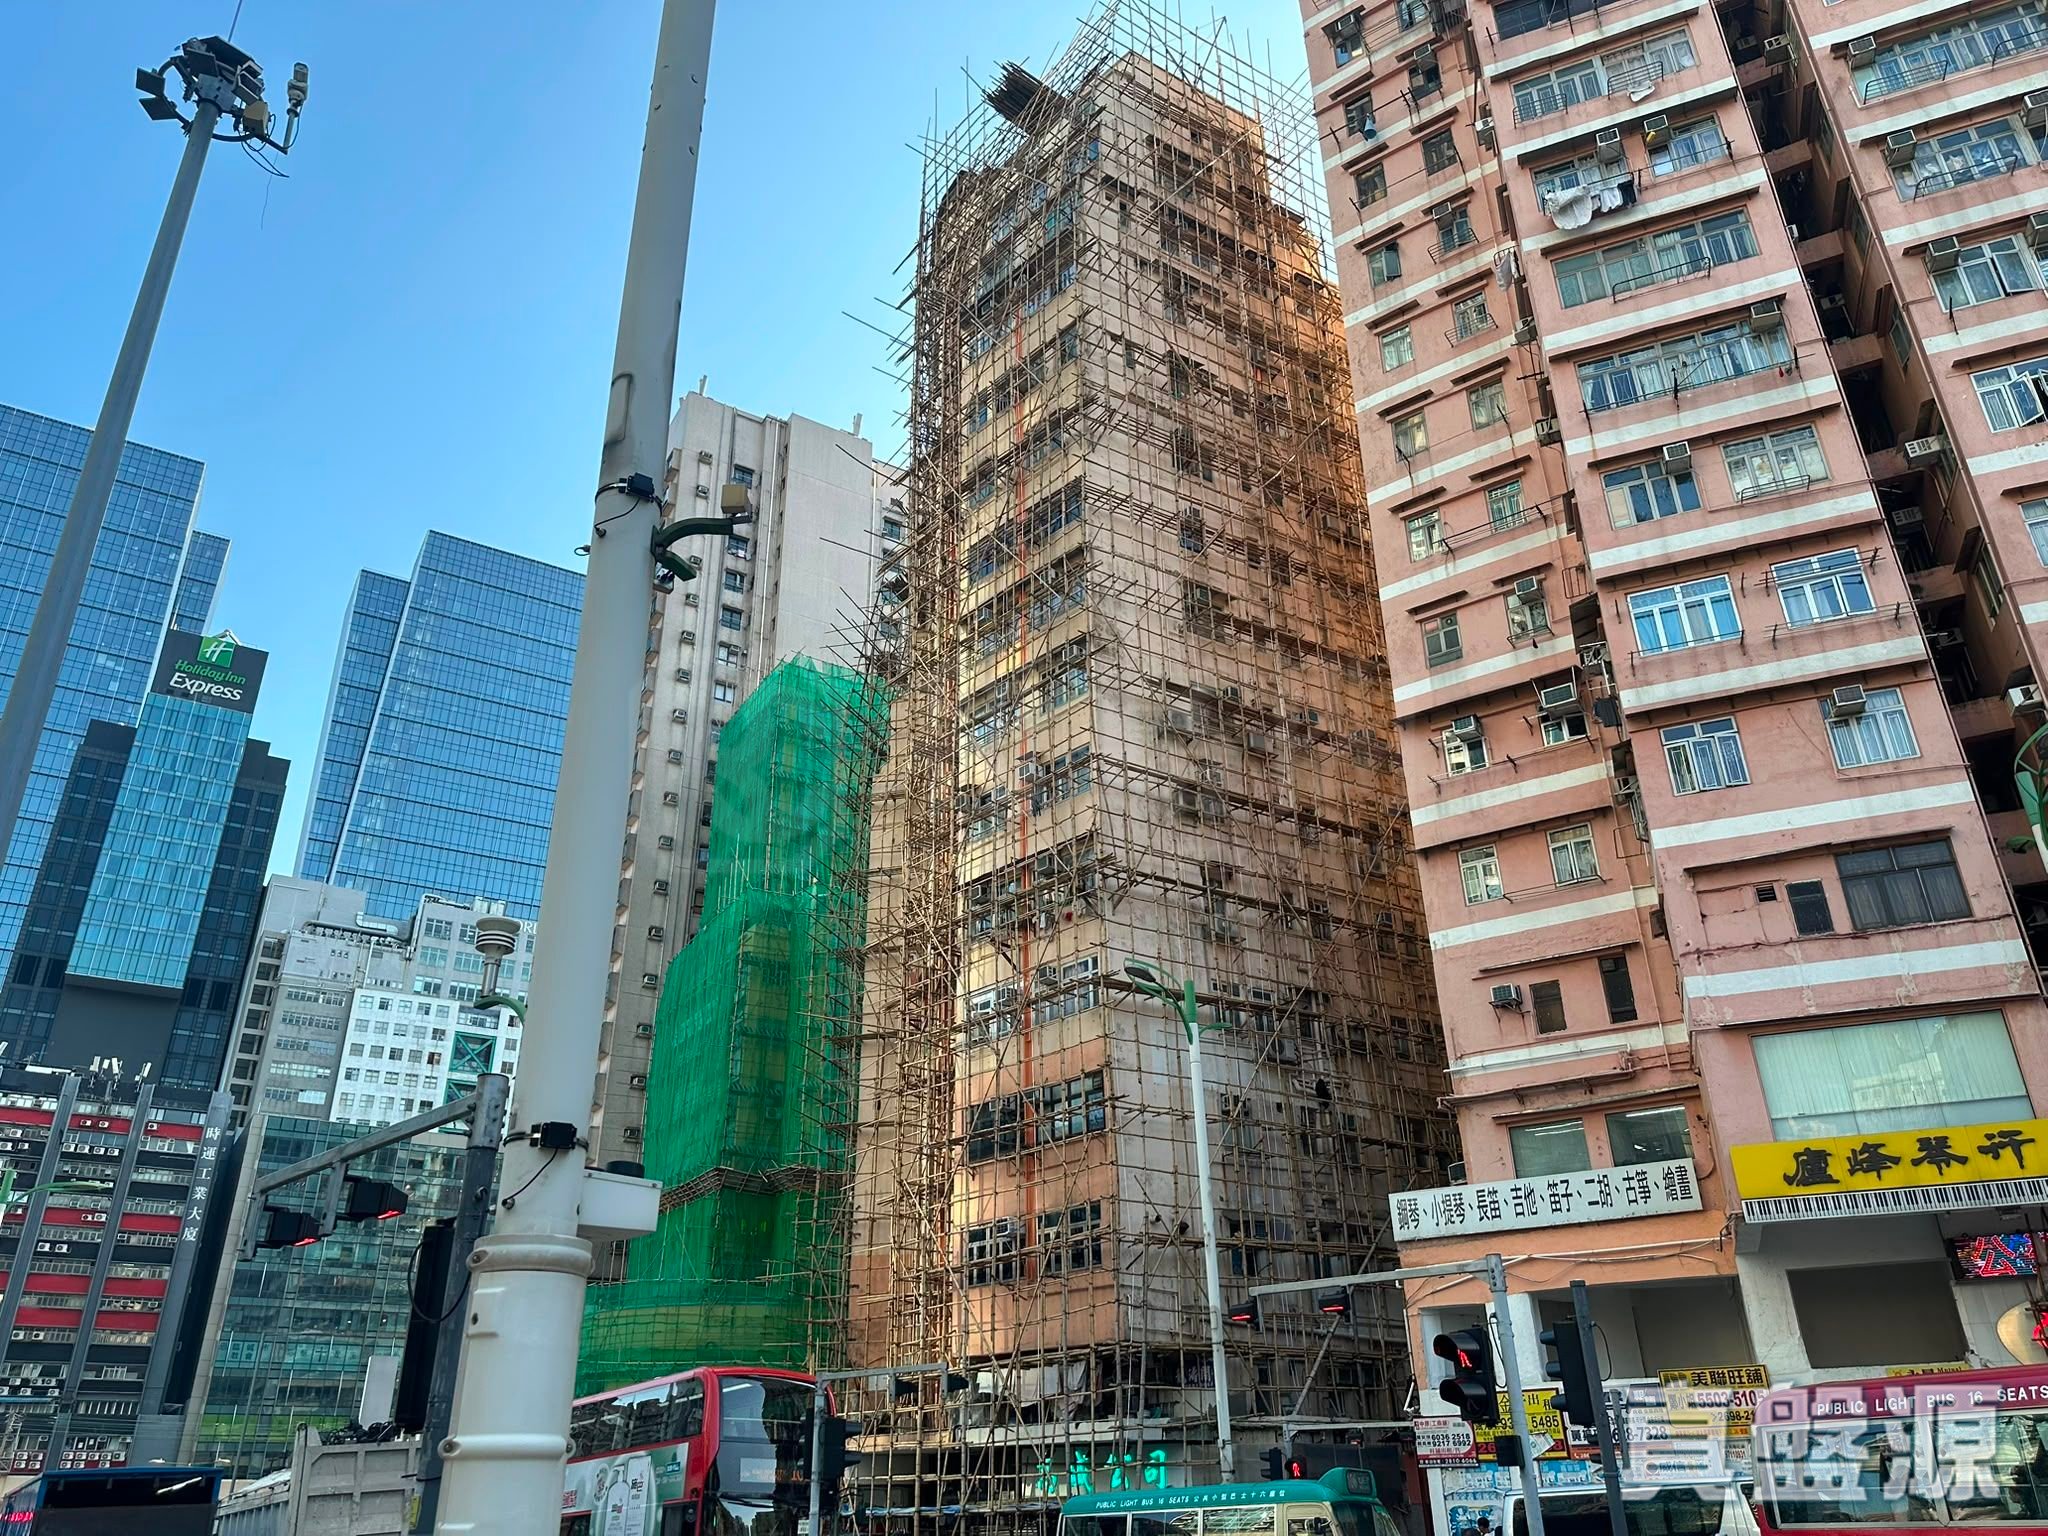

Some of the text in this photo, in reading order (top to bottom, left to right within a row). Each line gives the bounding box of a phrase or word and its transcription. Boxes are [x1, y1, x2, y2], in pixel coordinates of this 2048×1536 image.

[175, 659, 246, 685] Holiday Inn
[169, 672, 243, 701] Express
[1690, 1368, 1764, 1386] 美聯旺舖
[1817, 1385, 2048, 1416] PUBLIC LIGHT BUS 16 SEATS
[1531, 1415, 1560, 1429] 5485
[1096, 1501, 1116, 1509] PUBLIC
[1120, 1499, 1137, 1507] LIGHT
[1142, 1498, 1153, 1506] BUS
[1169, 1496, 1189, 1504] SEATS
